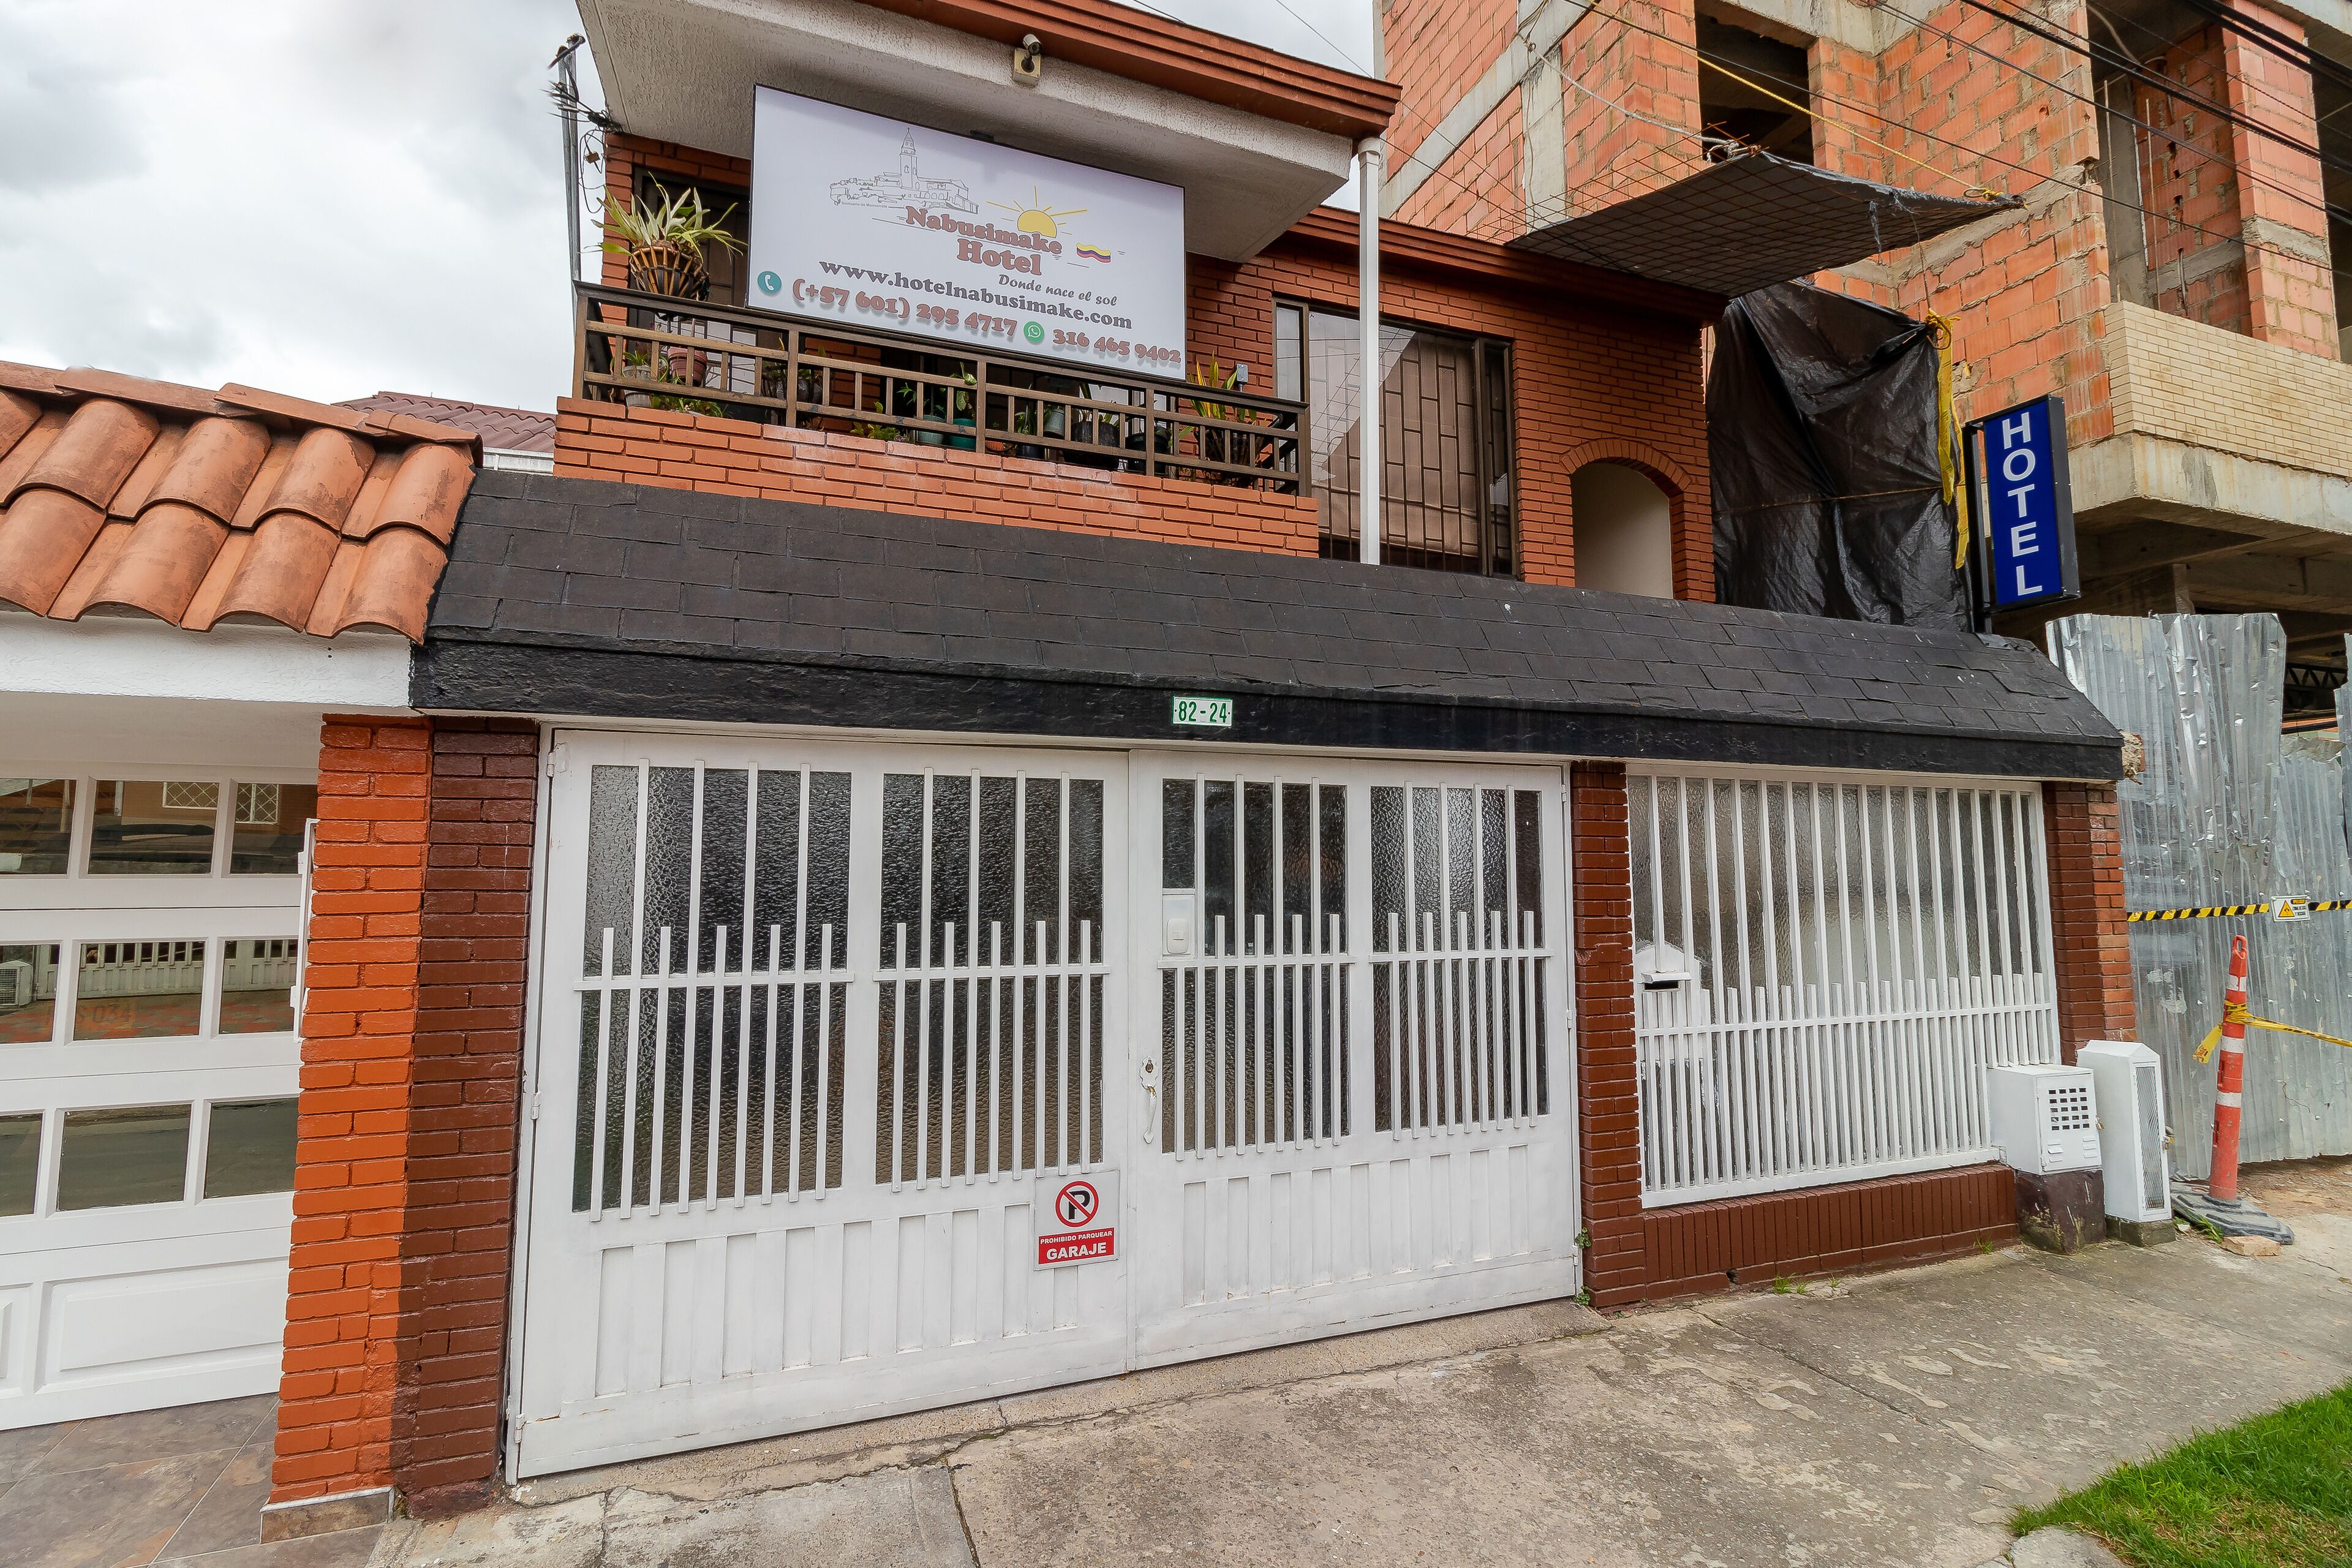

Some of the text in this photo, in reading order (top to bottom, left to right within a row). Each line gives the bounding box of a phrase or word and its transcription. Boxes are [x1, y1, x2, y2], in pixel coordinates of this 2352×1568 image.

[905, 206, 1063, 254] Nabusimake
[957, 239, 1042, 276] Hotel
[792, 278, 1018, 337] (+57 601) 295 4717
[819, 260, 1133, 330] www.hotelnabusimake.com
[998, 274, 1117, 306] Donde nace el sol
[1052, 328, 1182, 364] 316 465 9402
[2002, 411, 2043, 597] HOTEL
[1178, 700, 1227, 723] 82-24
[1040, 1230, 1113, 1245] PROHIBIDO PARQUEAR
[1046, 1242, 1107, 1261] GARAJE
